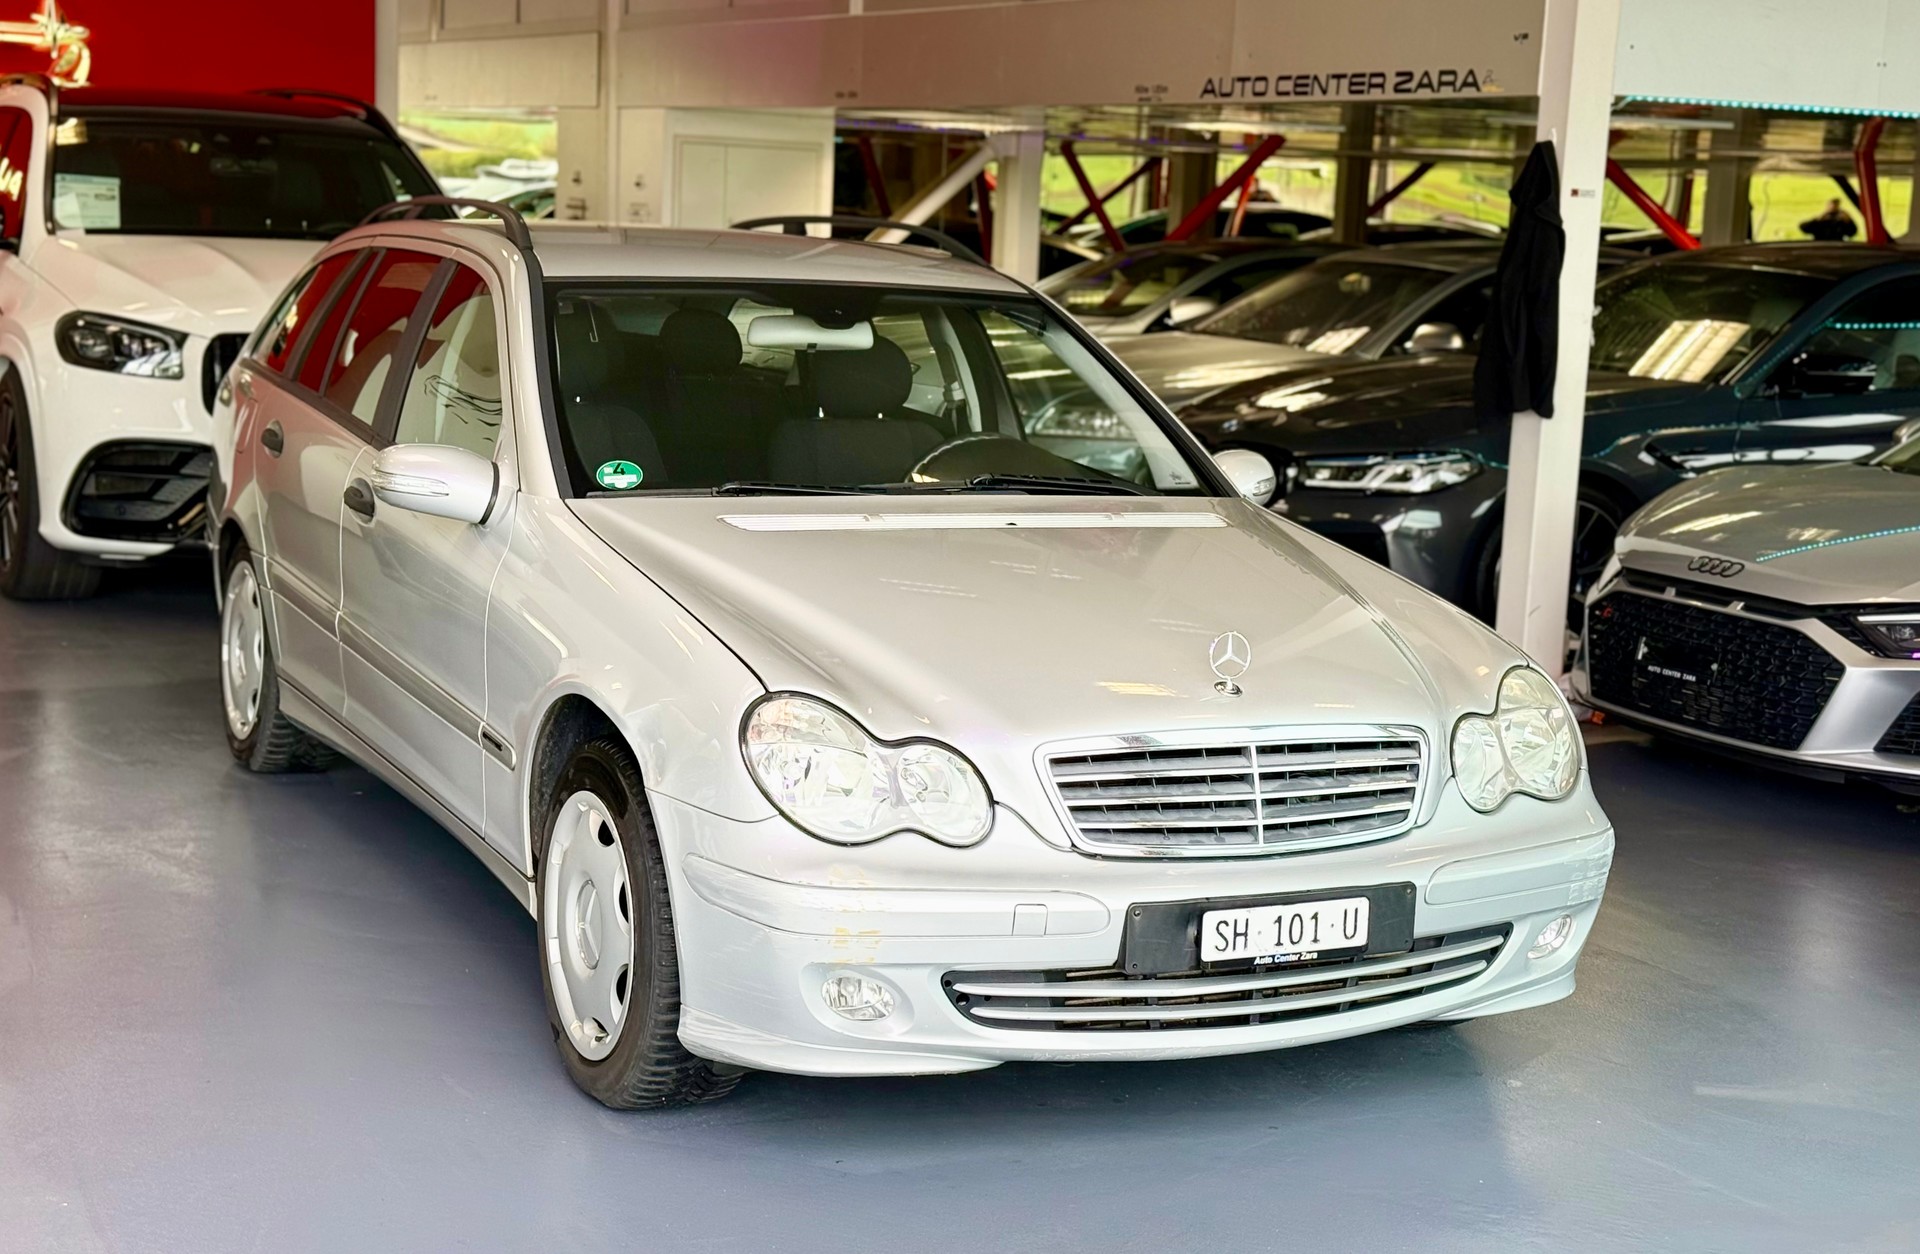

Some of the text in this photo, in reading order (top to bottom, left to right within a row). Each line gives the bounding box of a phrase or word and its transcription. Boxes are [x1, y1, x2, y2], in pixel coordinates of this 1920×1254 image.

[1200, 76, 1269, 98] AUTO
[1275, 72, 1387, 97] CENTER
[1393, 68, 1482, 94] ZARA
[612, 462, 626, 475] 4
[1647, 665, 1696, 682] AUTO CENTER ZARA
[1214, 907, 1359, 952] SH 101 U
[1254, 952, 1318, 965] Auto Center Zara
